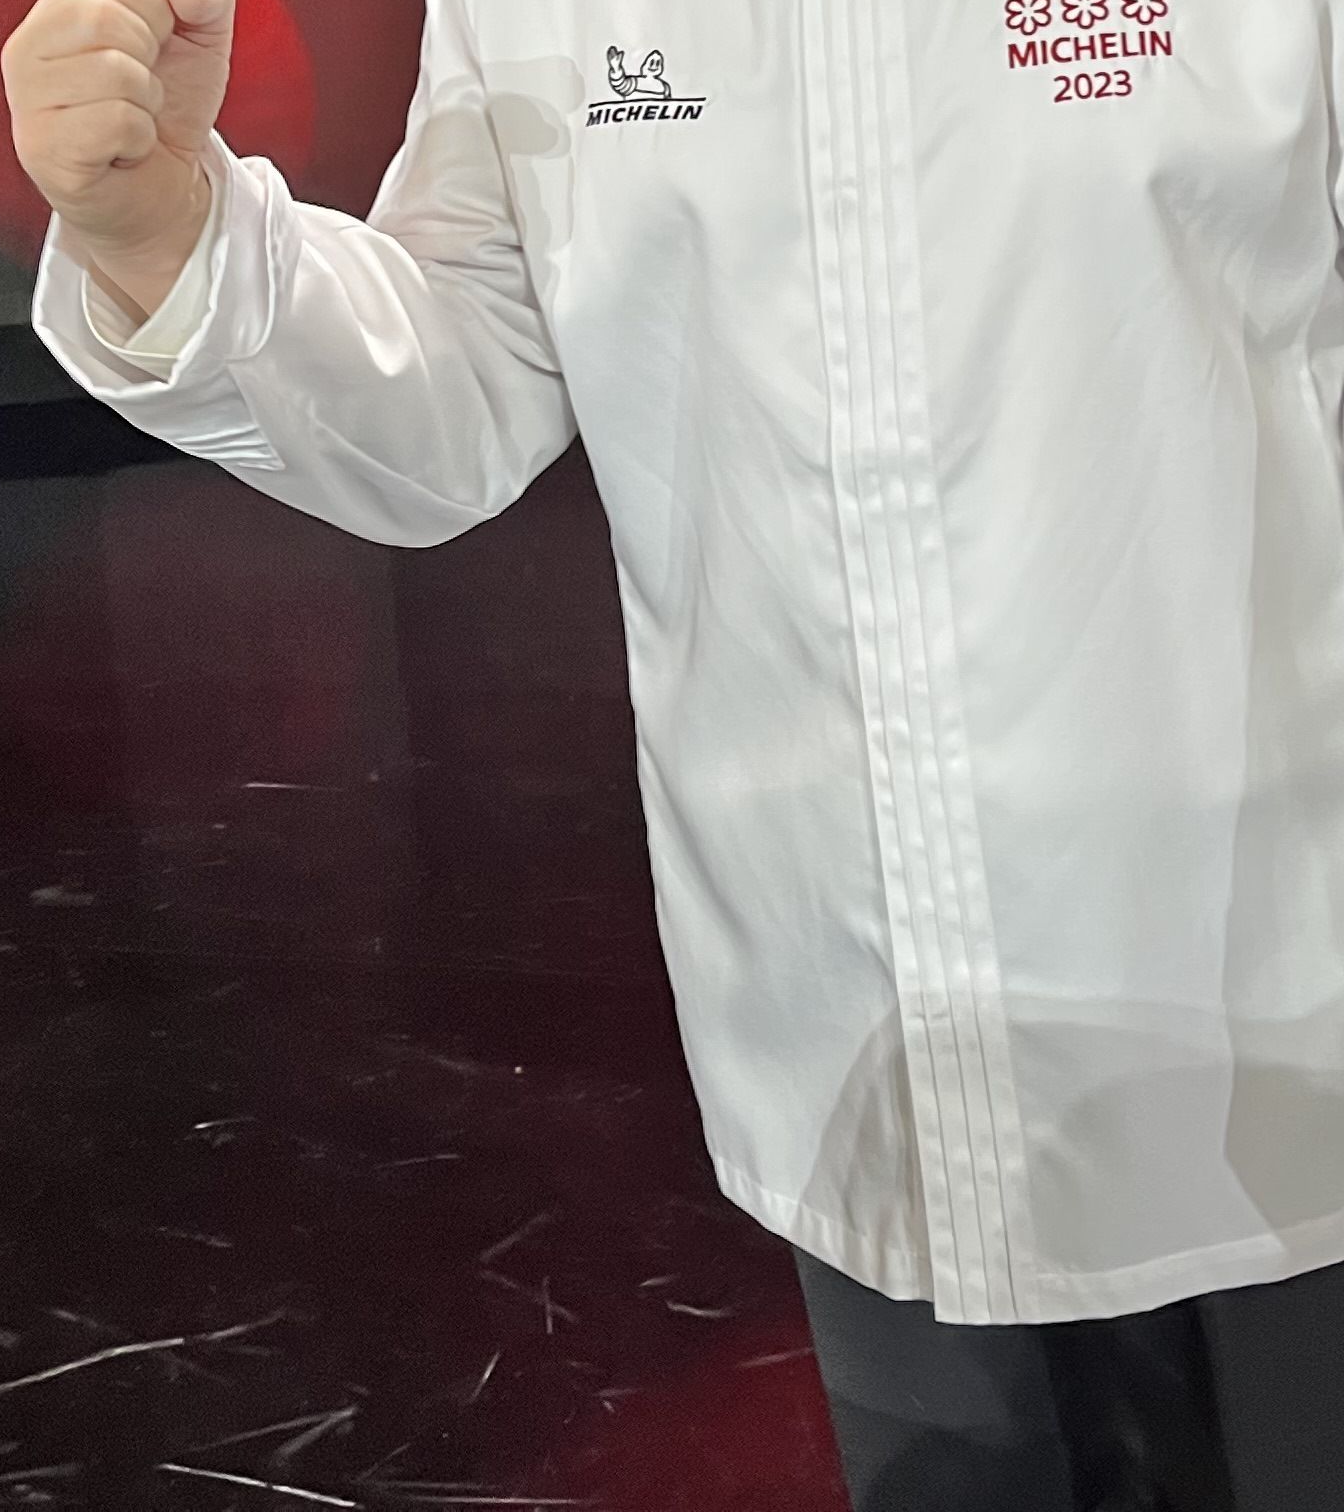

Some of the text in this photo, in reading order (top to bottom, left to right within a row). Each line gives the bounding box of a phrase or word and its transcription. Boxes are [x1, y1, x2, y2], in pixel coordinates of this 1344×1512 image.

[1007, 31, 1172, 69] MICHELIN
[1053, 70, 1132, 103] 2023
[585, 105, 703, 127] MICHELIN
